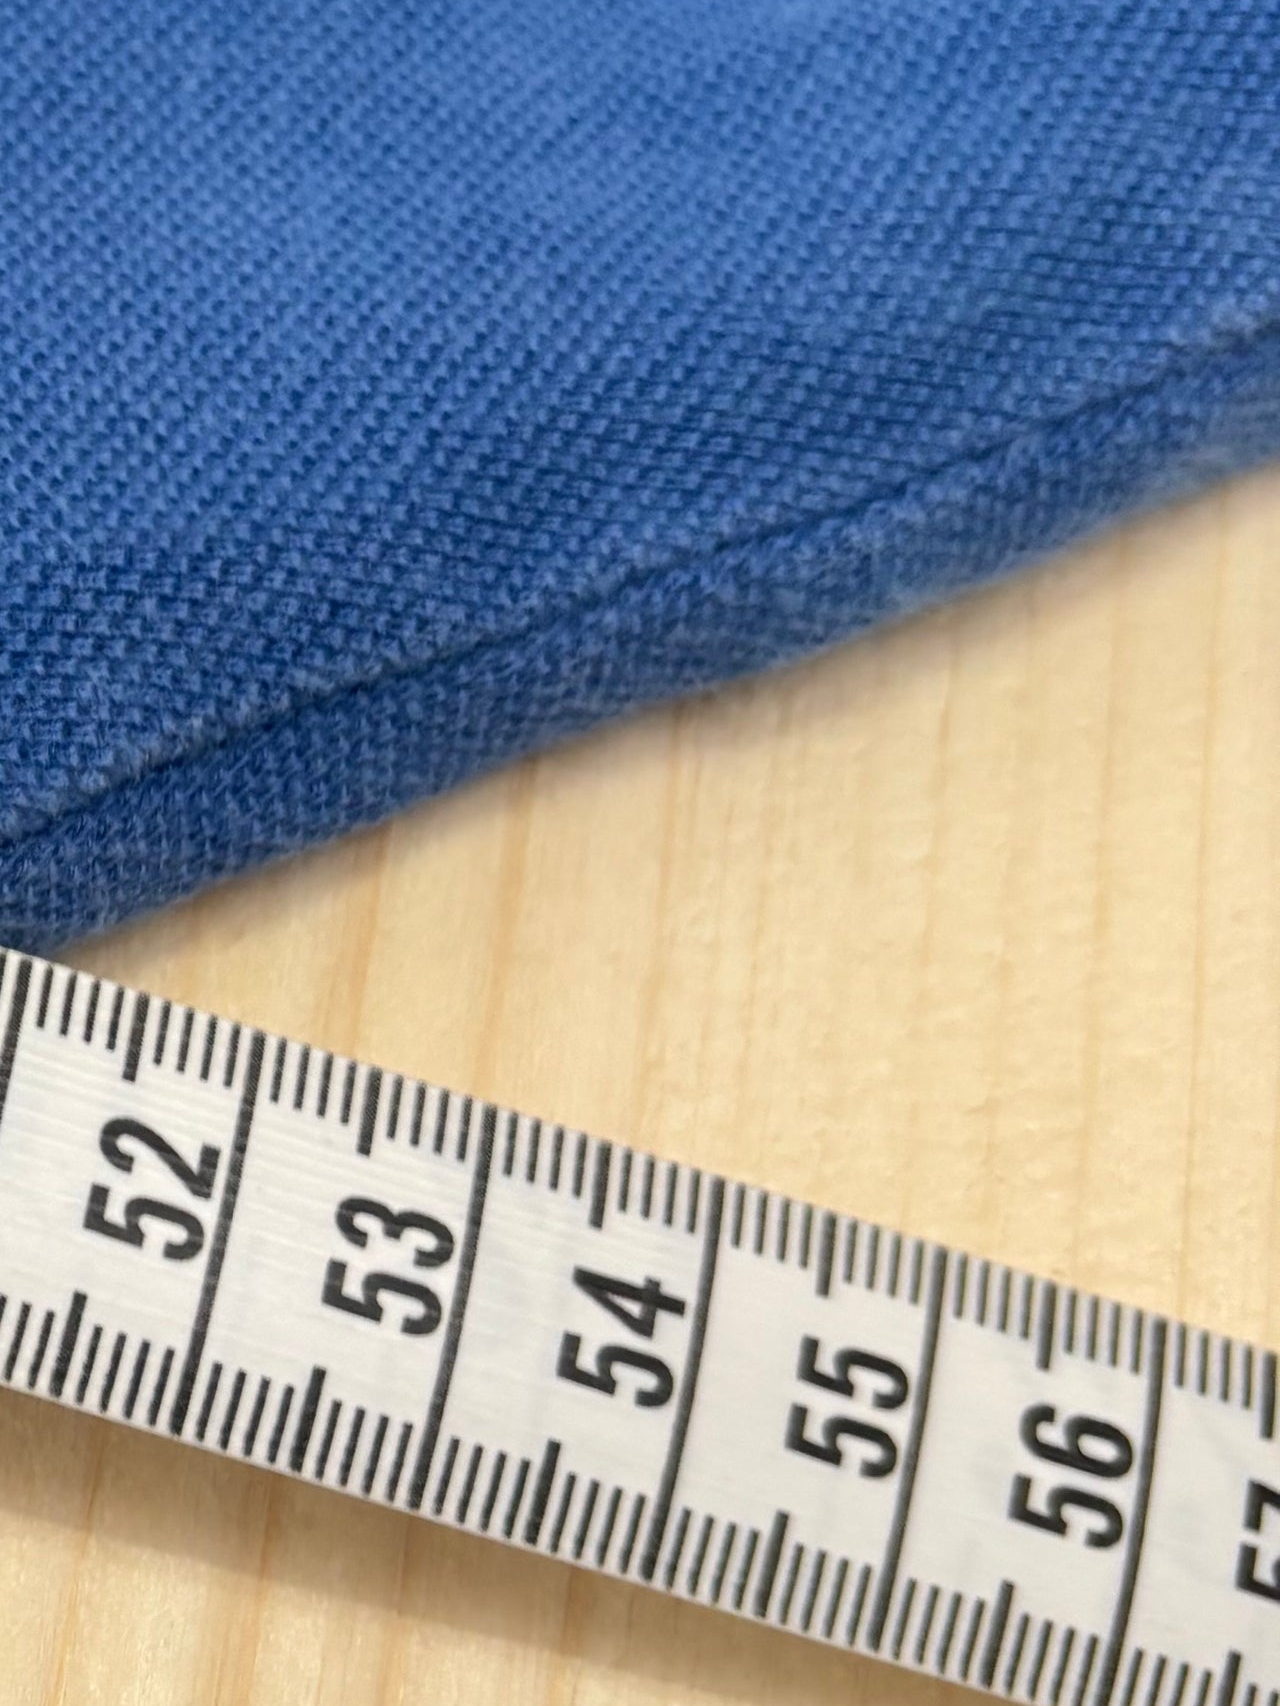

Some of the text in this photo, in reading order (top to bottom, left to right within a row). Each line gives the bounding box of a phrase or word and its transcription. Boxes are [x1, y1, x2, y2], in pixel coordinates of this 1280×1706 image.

[83, 1116, 221, 1261] 52
[322, 1196, 455, 1338] 53
[557, 1265, 687, 1408] 54
[785, 1335, 909, 1479] 55
[1008, 1403, 1134, 1550] 56
